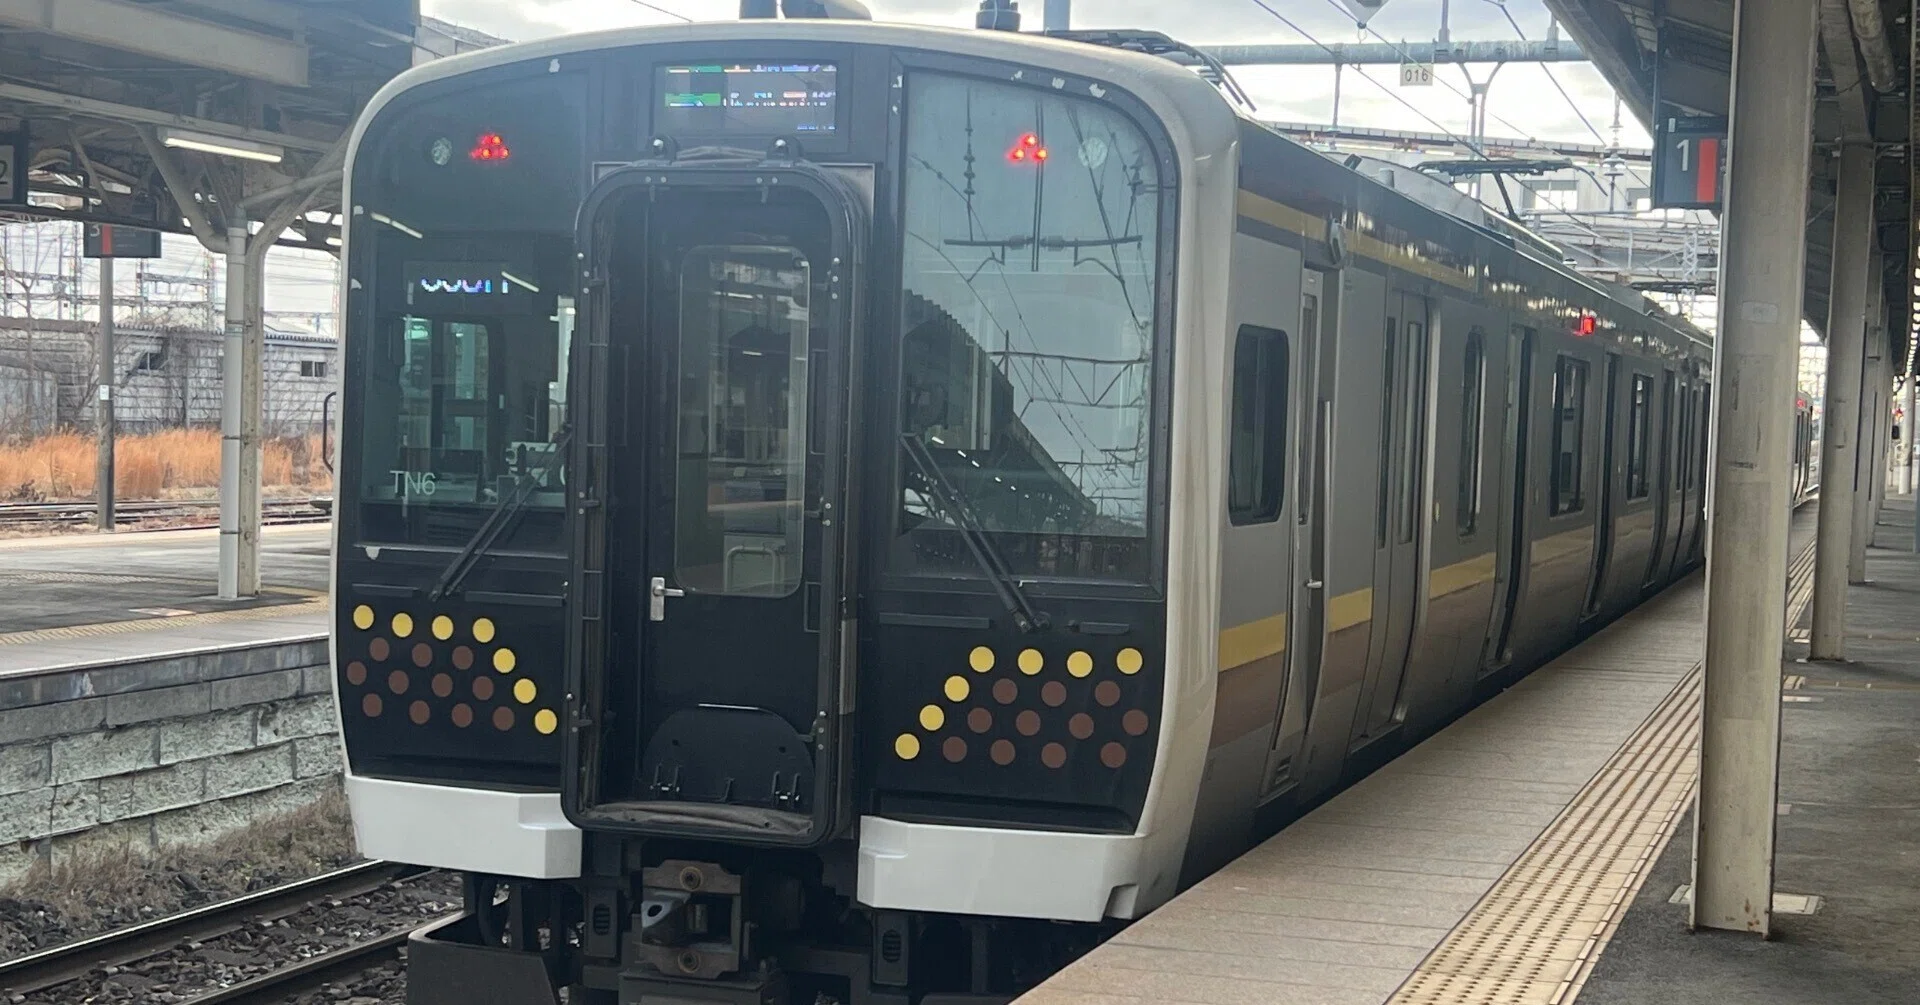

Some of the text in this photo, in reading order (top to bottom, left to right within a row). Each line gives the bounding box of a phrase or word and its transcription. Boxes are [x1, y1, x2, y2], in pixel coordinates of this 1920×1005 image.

[1405, 69, 1429, 81] 016
[1676, 139, 1690, 172] 1
[389, 470, 436, 495] TN6
